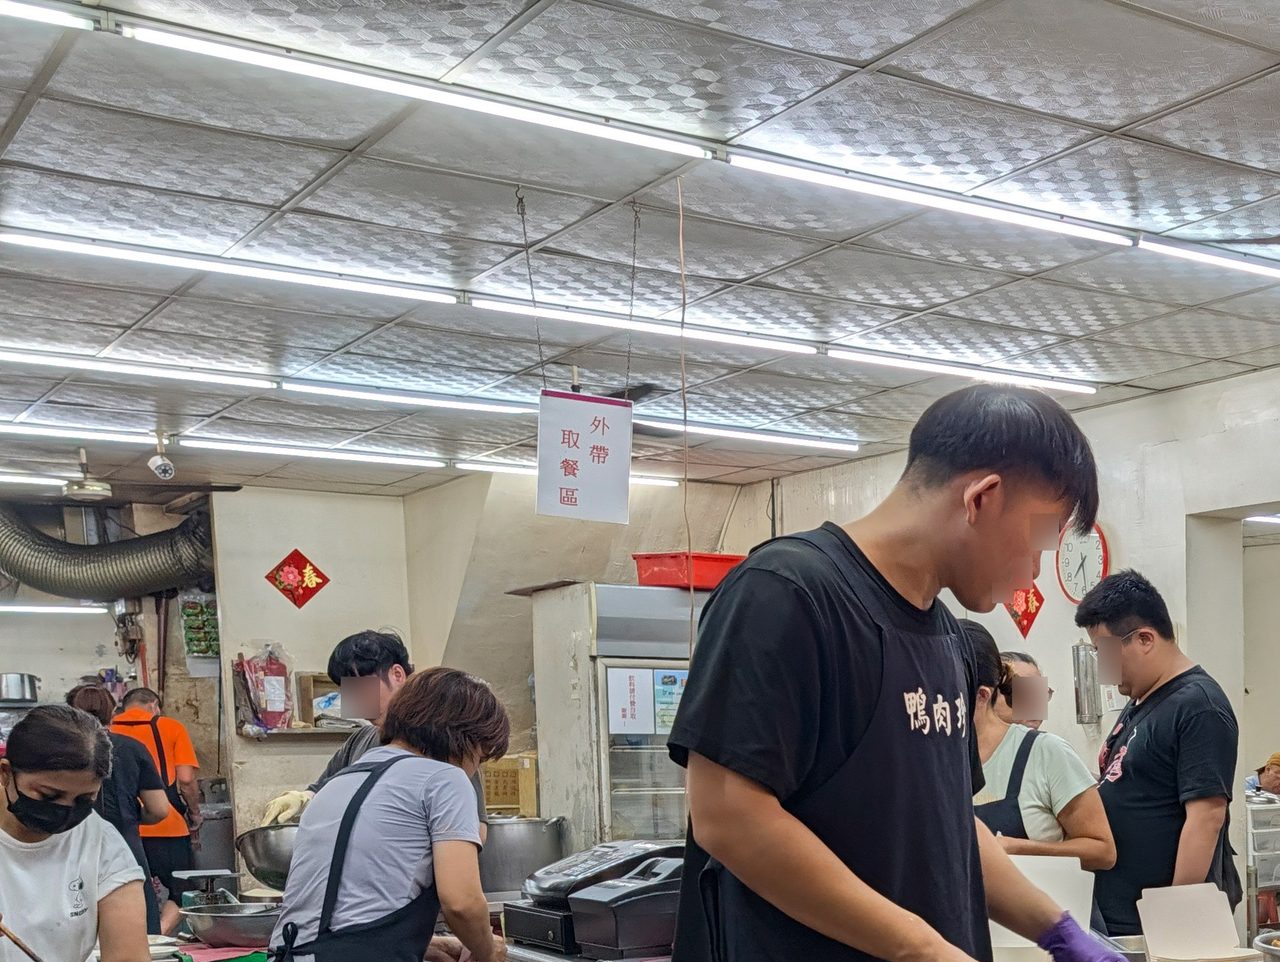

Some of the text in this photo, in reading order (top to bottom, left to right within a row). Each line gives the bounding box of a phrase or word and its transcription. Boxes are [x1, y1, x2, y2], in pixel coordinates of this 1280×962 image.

[590, 416, 610, 464] 外帶
[559, 429, 580, 506] 取餐區
[1064, 542, 1074, 552] 10
[1095, 540, 1101, 550] 2
[1064, 557, 1070, 567] 9
[1097, 555, 1103, 565] 3
[302, 563, 323, 588] 春
[1066, 572, 1073, 582] 8
[1074, 582, 1079, 591] 7
